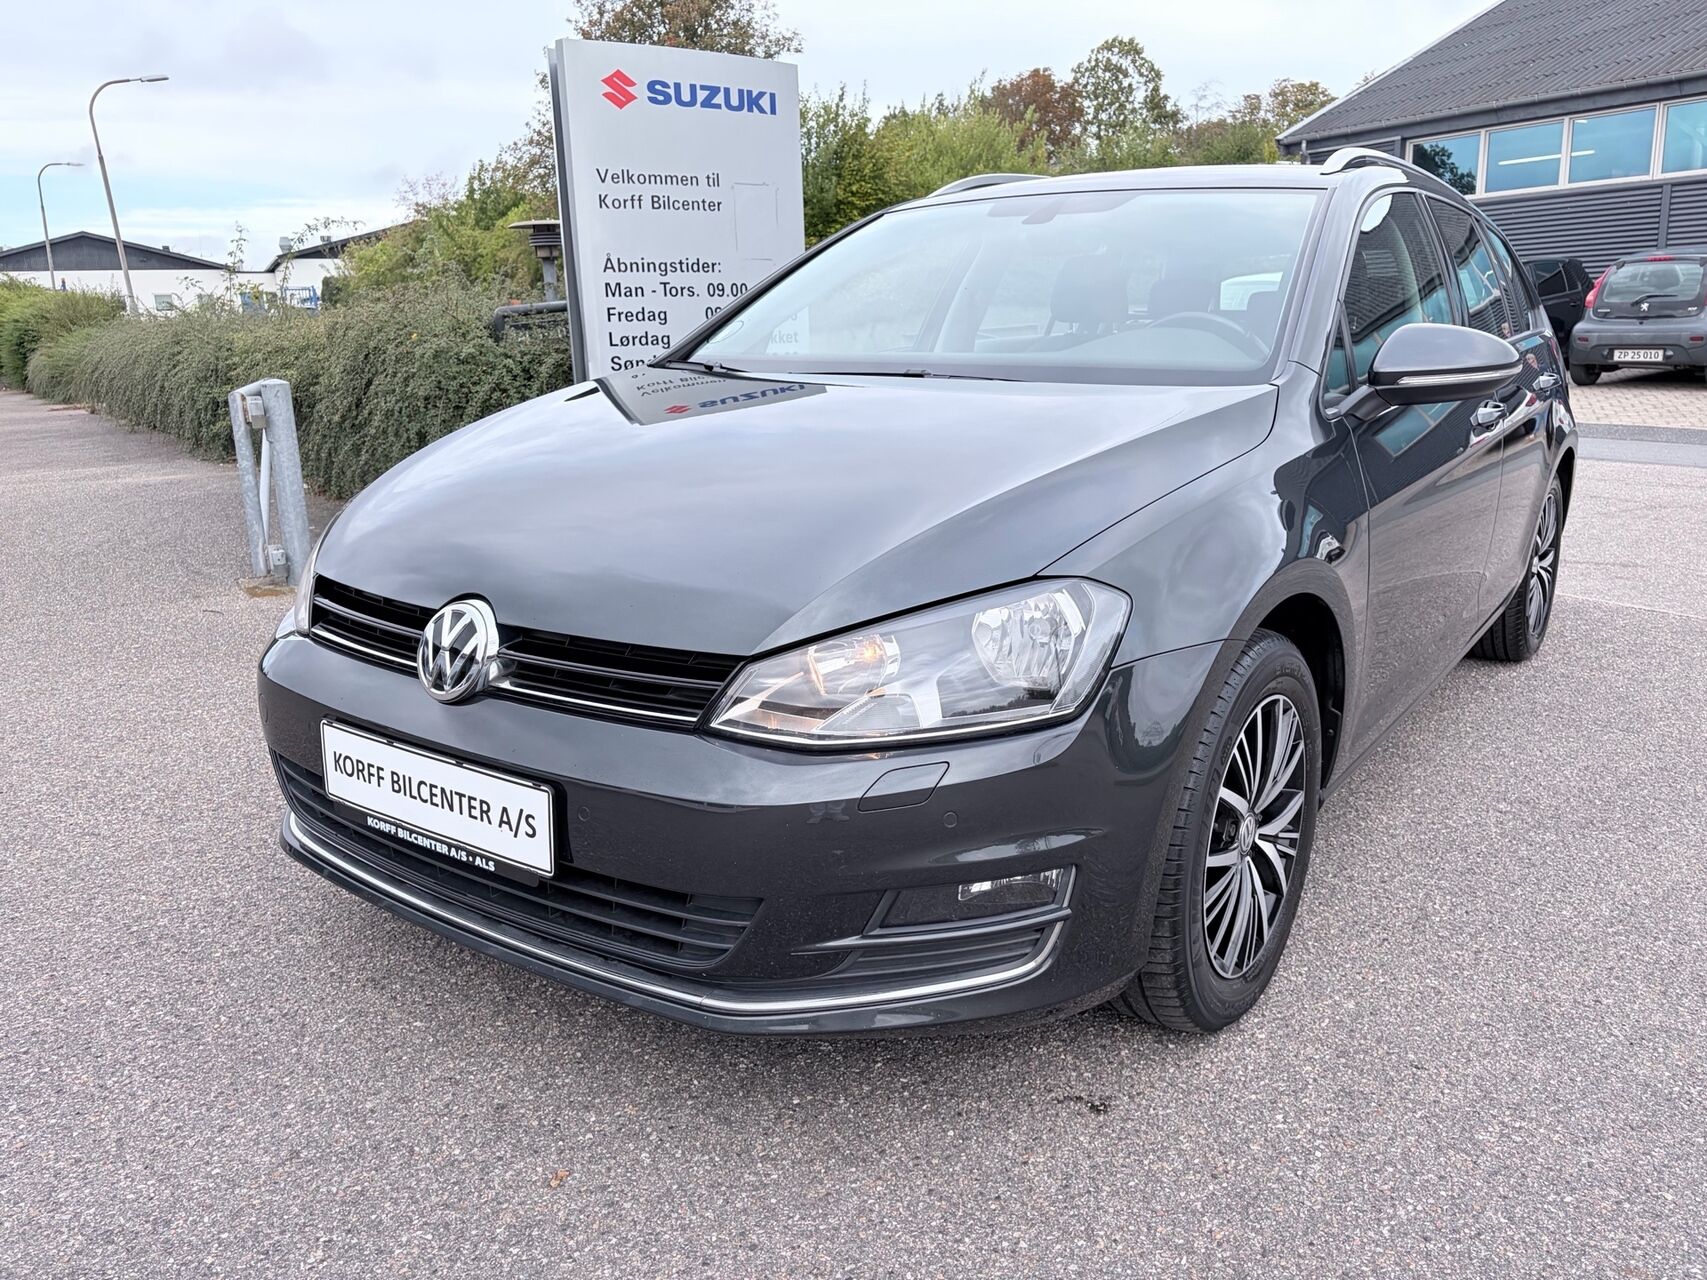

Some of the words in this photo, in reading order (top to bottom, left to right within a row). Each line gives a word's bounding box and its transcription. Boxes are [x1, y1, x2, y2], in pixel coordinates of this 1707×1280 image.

[646, 79, 777, 116] SUZUKI
[595, 168, 699, 187] Velkommen
[705, 172, 720, 188] til
[598, 194, 643, 210] Korff
[650, 194, 722, 212] Bilcenter
[603, 252, 722, 276] Åbningstider:
[604, 282, 645, 298] Man
[659, 282, 700, 298] Tors.
[606, 306, 668, 325] Fredag
[608, 331, 671, 349] Lørdag
[1617, 351, 1629, 359] ZP
[1631, 351, 1642, 359] 25
[1643, 351, 1660, 360] 010
[333, 750, 385, 788] KORFF
[390, 770, 492, 825] BILCENTER
[498, 806, 537, 839] A/S
[367, 816, 397, 836] KORFF
[397, 824, 449, 856] BILCENTER
[450, 845, 467, 862] A/S
[475, 857, 495, 872] ALS
